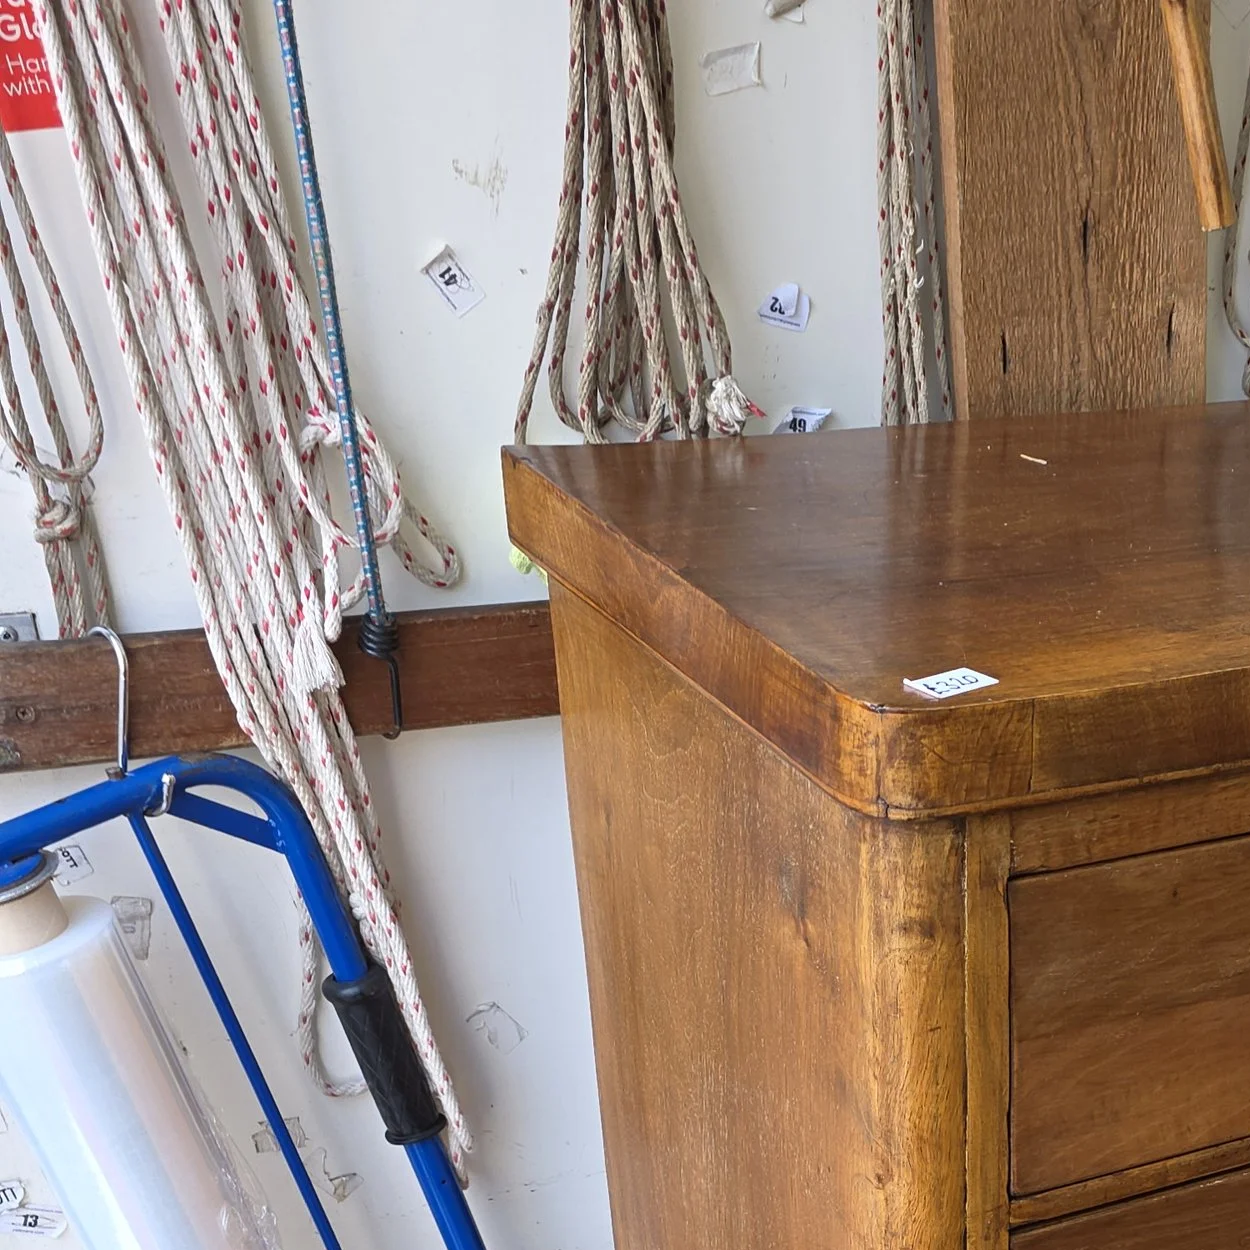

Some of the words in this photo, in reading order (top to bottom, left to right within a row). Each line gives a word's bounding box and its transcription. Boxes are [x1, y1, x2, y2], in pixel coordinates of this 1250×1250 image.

[3, 73, 51, 96] with
[439, 265, 457, 286] 41
[789, 417, 807, 433] 49
[923, 675, 979, 695] £320
[22, 1213, 39, 1228] 13
